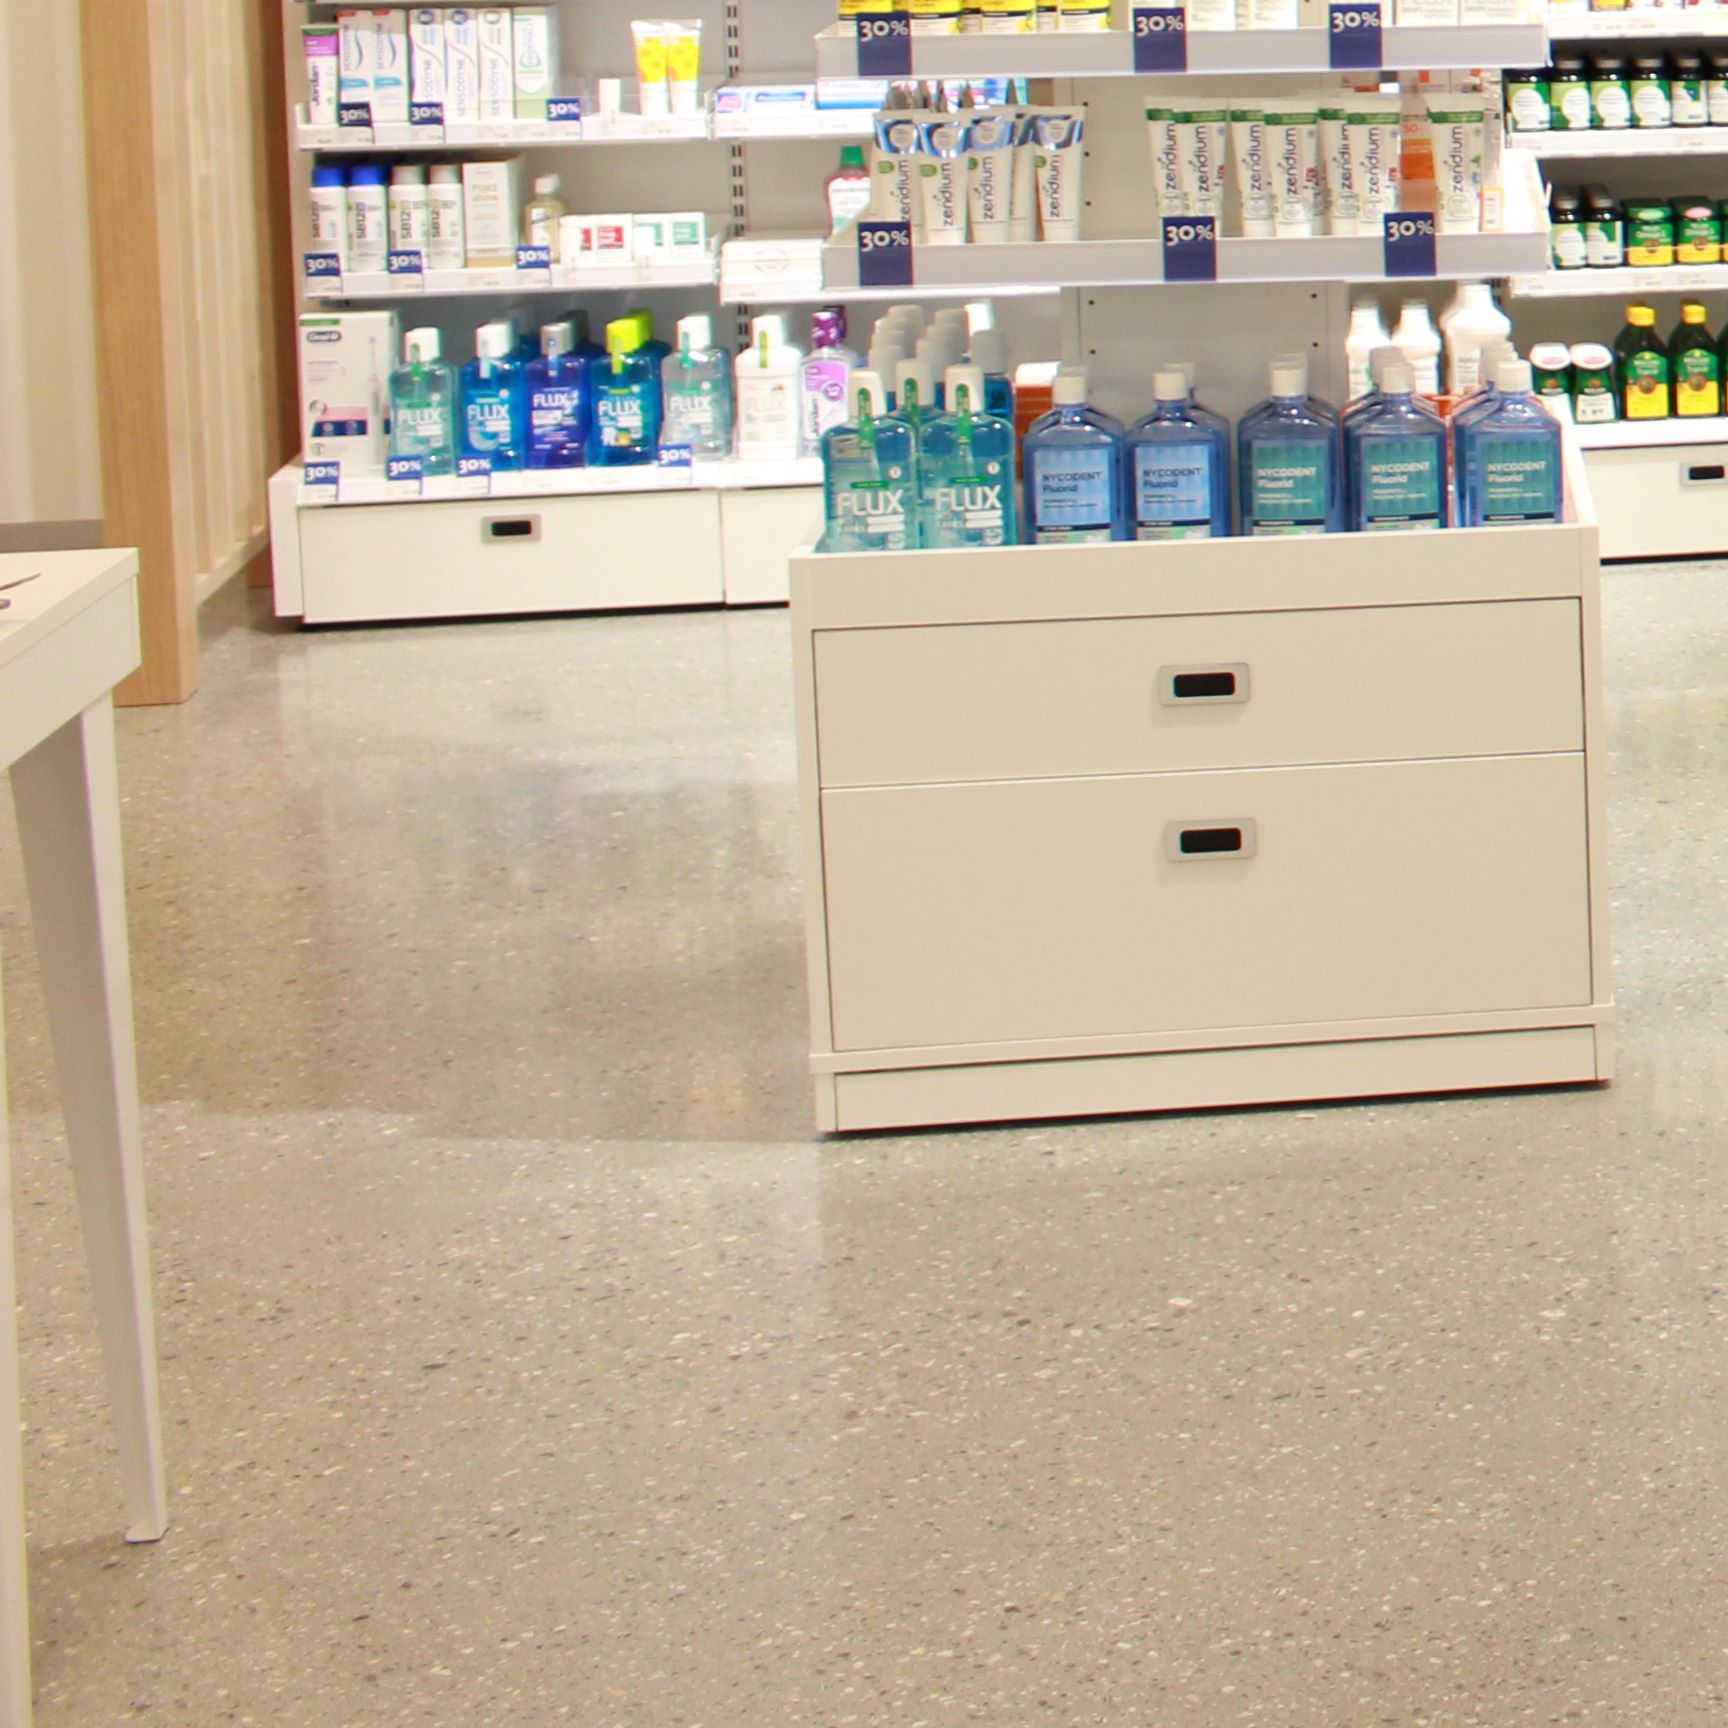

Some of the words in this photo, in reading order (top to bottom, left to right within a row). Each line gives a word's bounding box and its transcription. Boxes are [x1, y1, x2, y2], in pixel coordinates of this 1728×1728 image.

[1136, 15, 1183, 37] 30%
[1332, 11, 1379, 33] 30%
[860, 21, 908, 42] 30%
[340, 109, 369, 122] 30%
[550, 103, 580, 116] 30%
[1166, 224, 1213, 247] 30%
[1388, 221, 1434, 241] 30%
[861, 230, 909, 252] 30%
[518, 249, 549, 264] 30%
[532, 393, 569, 408] FLUX
[598, 399, 642, 414] FLUX
[467, 404, 510, 421] FLUX
[389, 461, 421, 475] 30%
[1143, 467, 1203, 478] NYCODENT
[1371, 461, 1431, 473] NYCODENT
[1042, 472, 1101, 482] NYCODENT
[1143, 479, 1179, 489] Fluorid
[1371, 474, 1409, 484] Fluorid
[1042, 483, 1079, 493] Fluorid
[836, 490, 904, 516] FLUX
[935, 485, 1003, 512] FLUX
